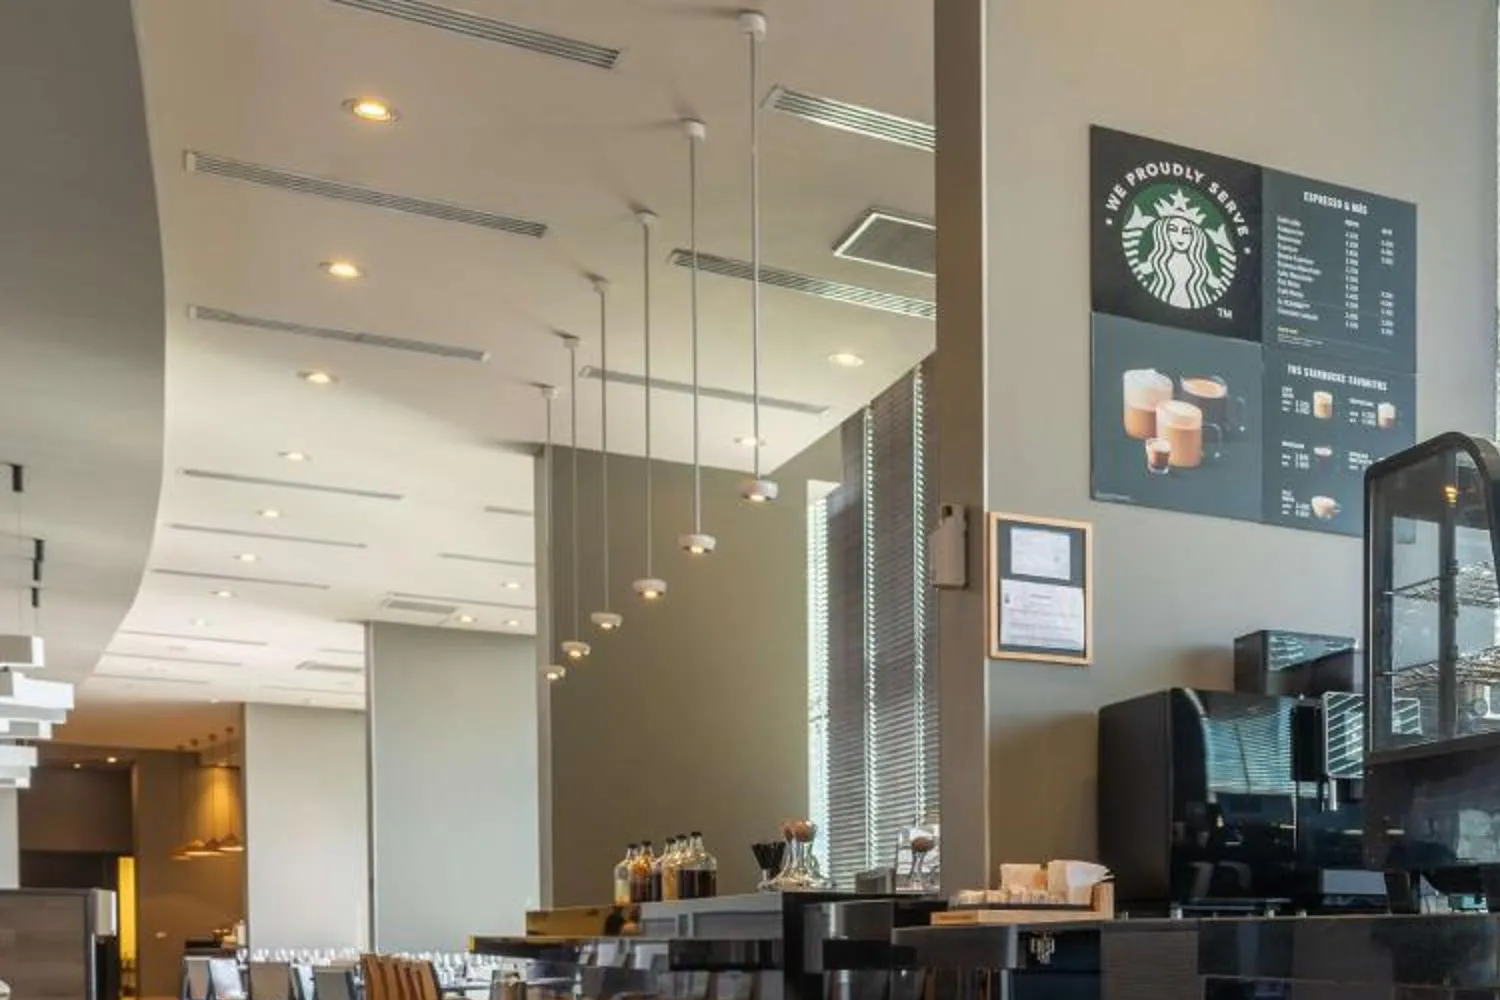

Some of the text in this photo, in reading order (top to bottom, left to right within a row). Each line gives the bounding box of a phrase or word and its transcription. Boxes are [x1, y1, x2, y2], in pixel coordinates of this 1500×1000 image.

[1105, 161, 1250, 238] WE PROUDLY SERVE
[1216, 307, 1233, 319] TM
